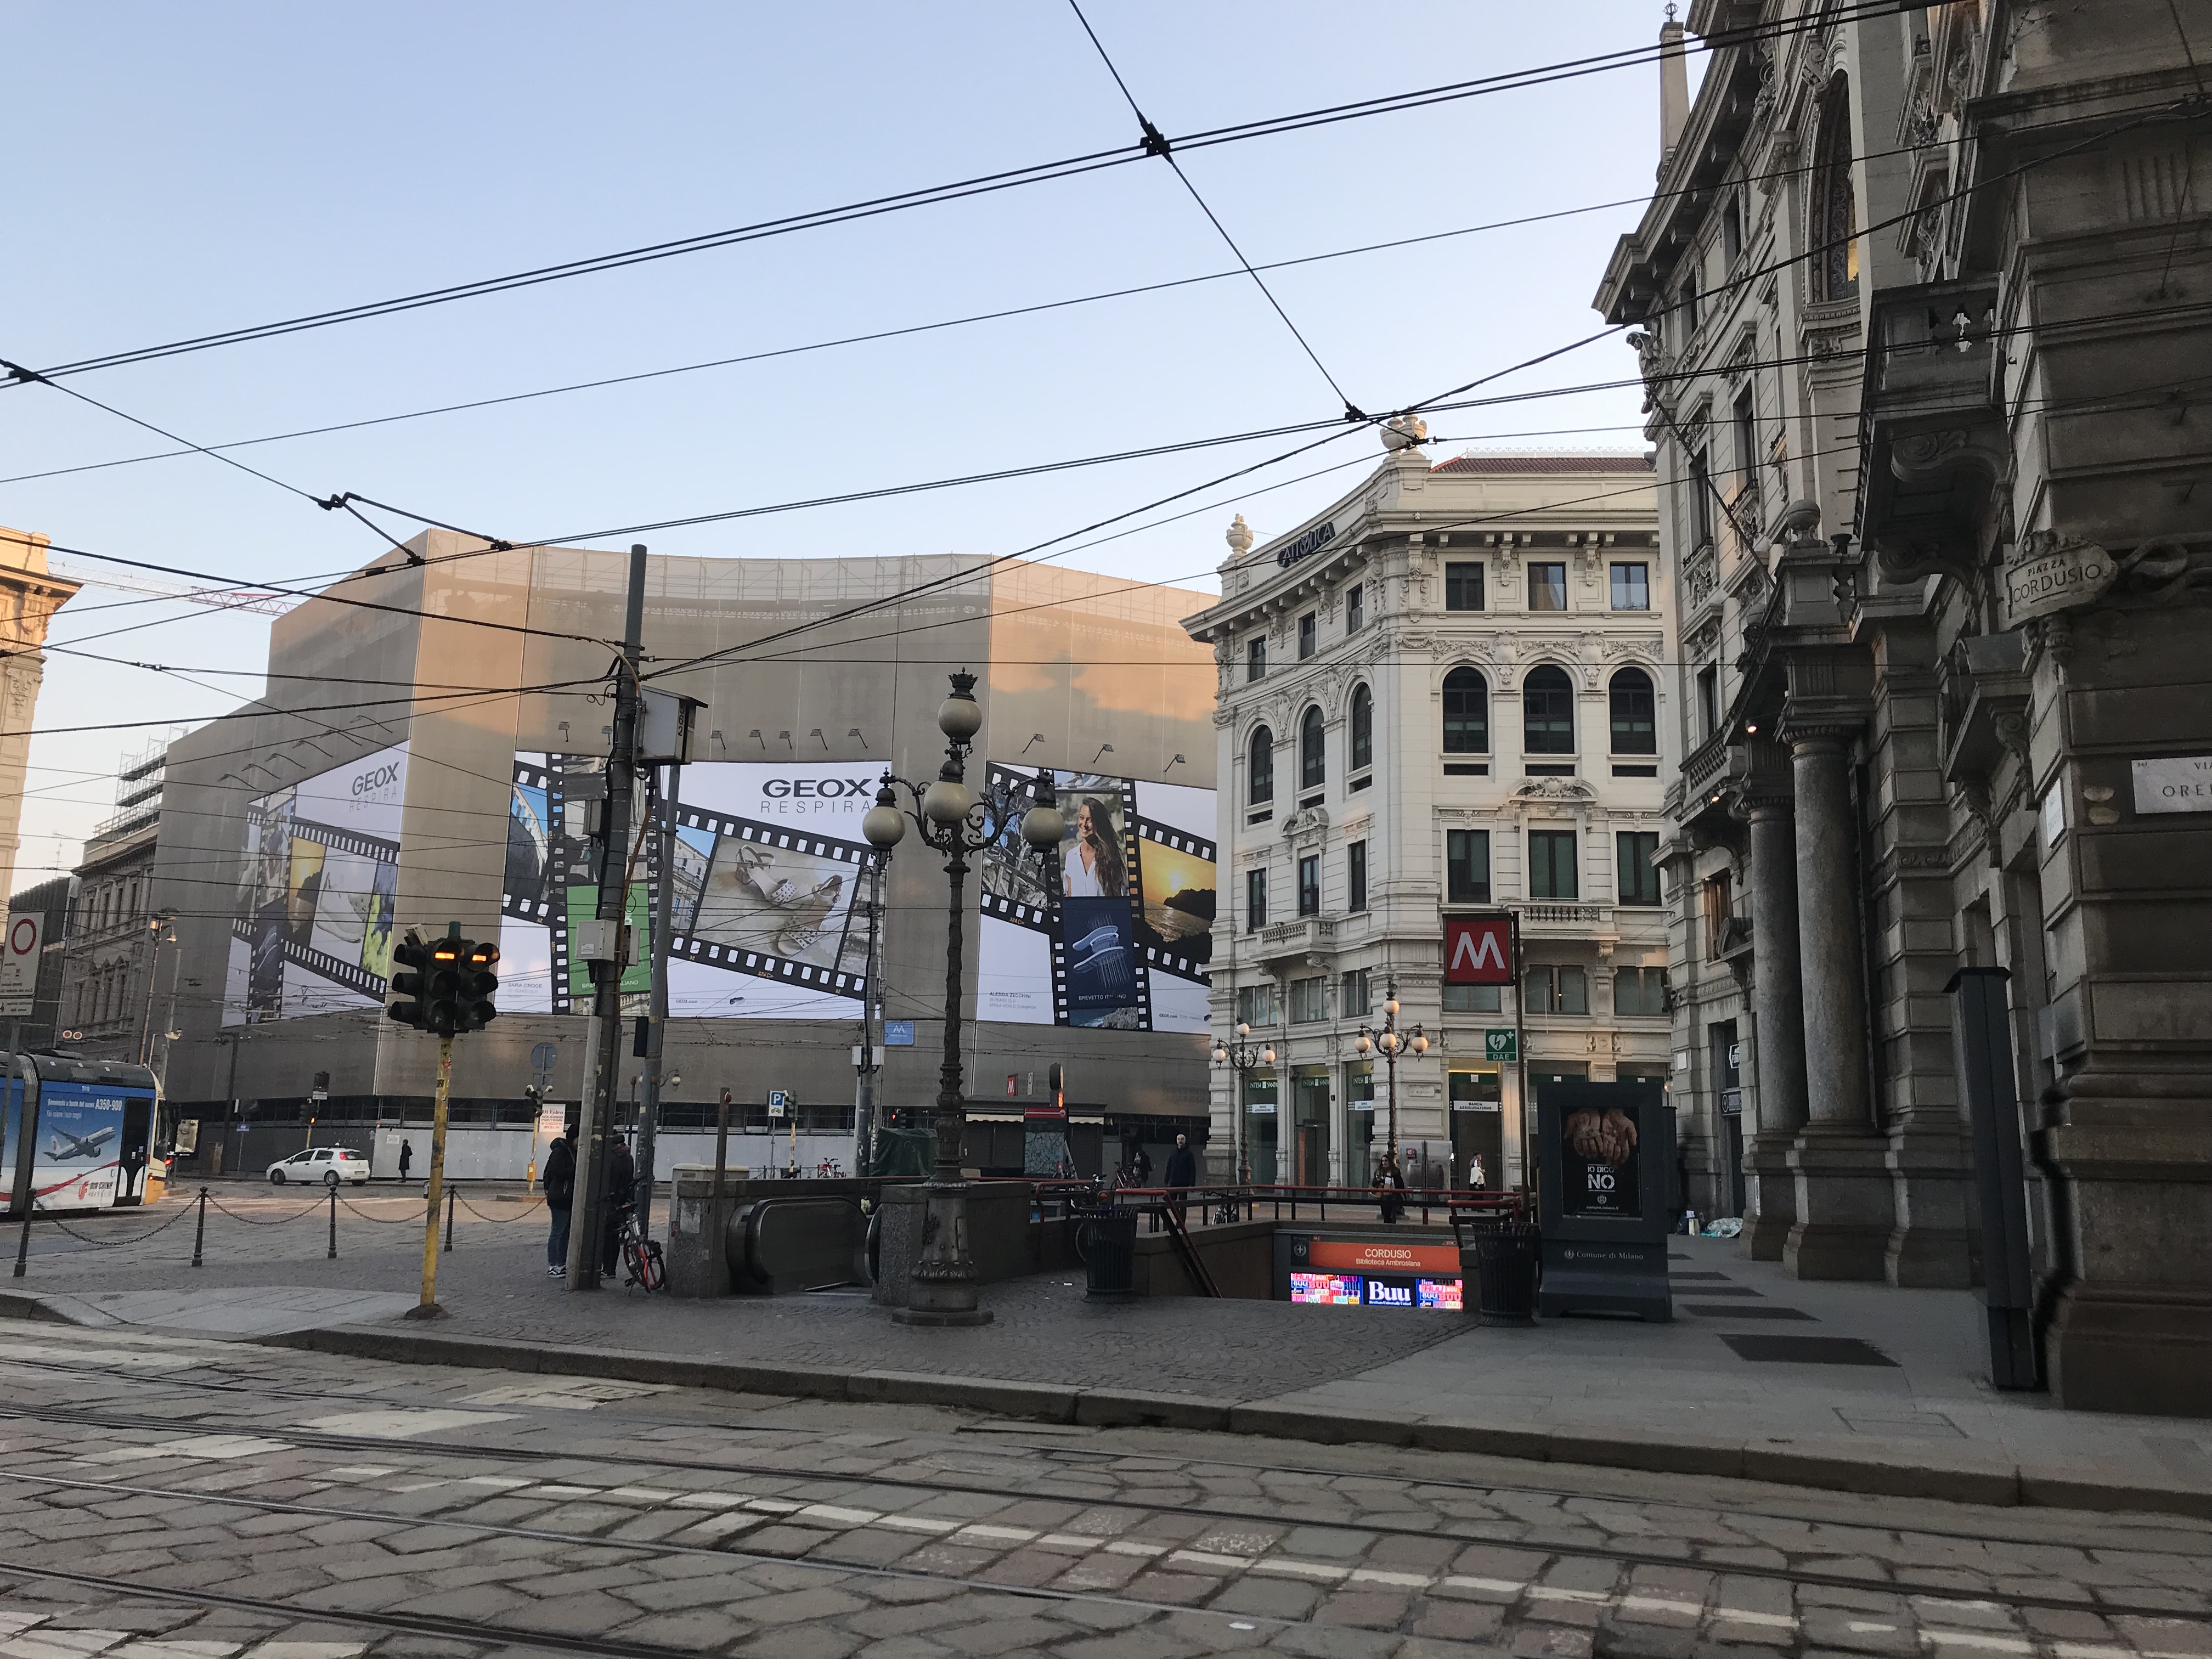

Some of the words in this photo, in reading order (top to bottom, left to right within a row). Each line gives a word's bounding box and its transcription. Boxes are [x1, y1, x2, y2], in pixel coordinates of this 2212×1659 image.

[1277, 522, 1334, 567] CATTOLICA
[2028, 558, 2065, 577] PIAZZA
[2013, 564, 2101, 602] CORDUSIO
[352, 761, 399, 795] GEOX
[763, 778, 872, 798] GEOX
[2163, 784, 2212, 797] ORE
[349, 785, 396, 812] RESPIRA
[760, 800, 871, 813] RESPIRA
[1451, 932, 1505, 969] M
[95, 1099, 122, 1111] A350-900
[774, 1093, 781, 1104] P
[1588, 1173, 1615, 1189] NO
[1365, 1249, 1412, 1259] CORDUSIO
[1368, 1281, 1411, 1301] Buu
